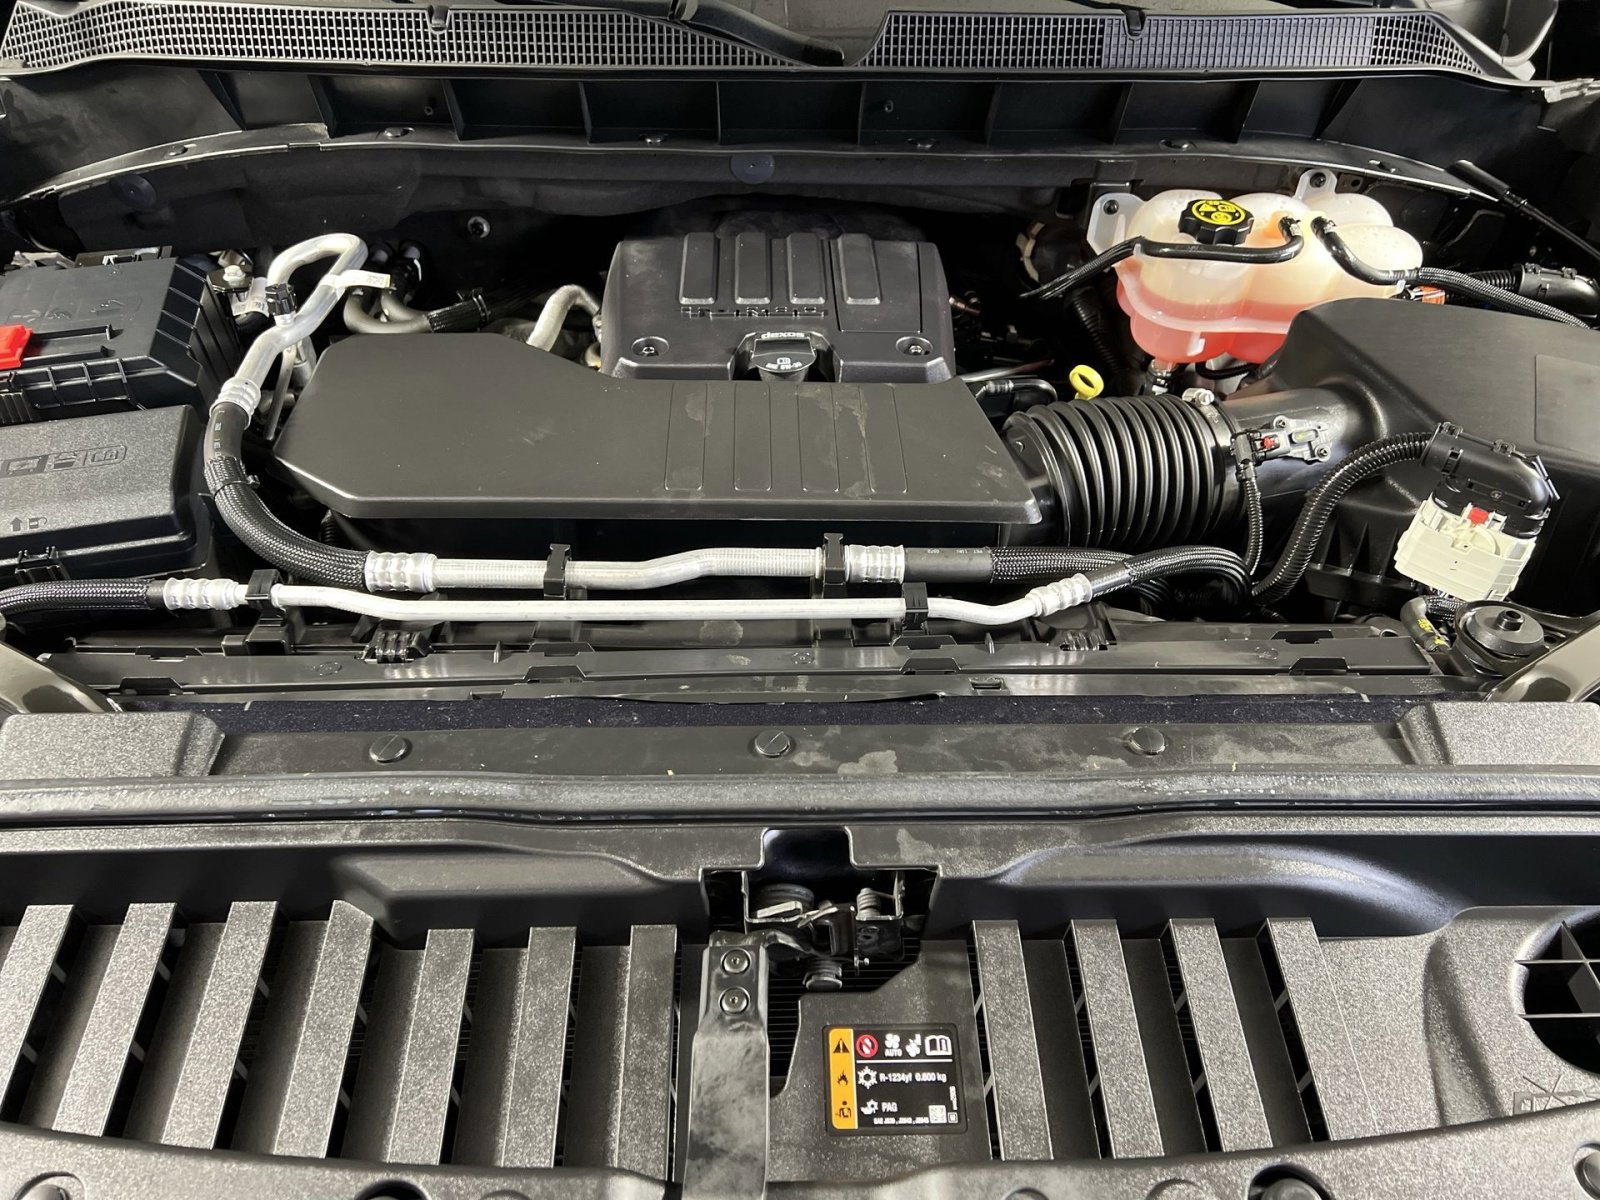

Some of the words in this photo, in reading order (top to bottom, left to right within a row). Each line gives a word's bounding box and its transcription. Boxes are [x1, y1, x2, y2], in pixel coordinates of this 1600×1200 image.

[761, 331, 805, 339] dexos
[885, 1049, 902, 1057] AUTO
[879, 1072, 912, 1083] R-1234yf
[937, 1072, 947, 1083] kg
[881, 1102, 898, 1112] PAG
